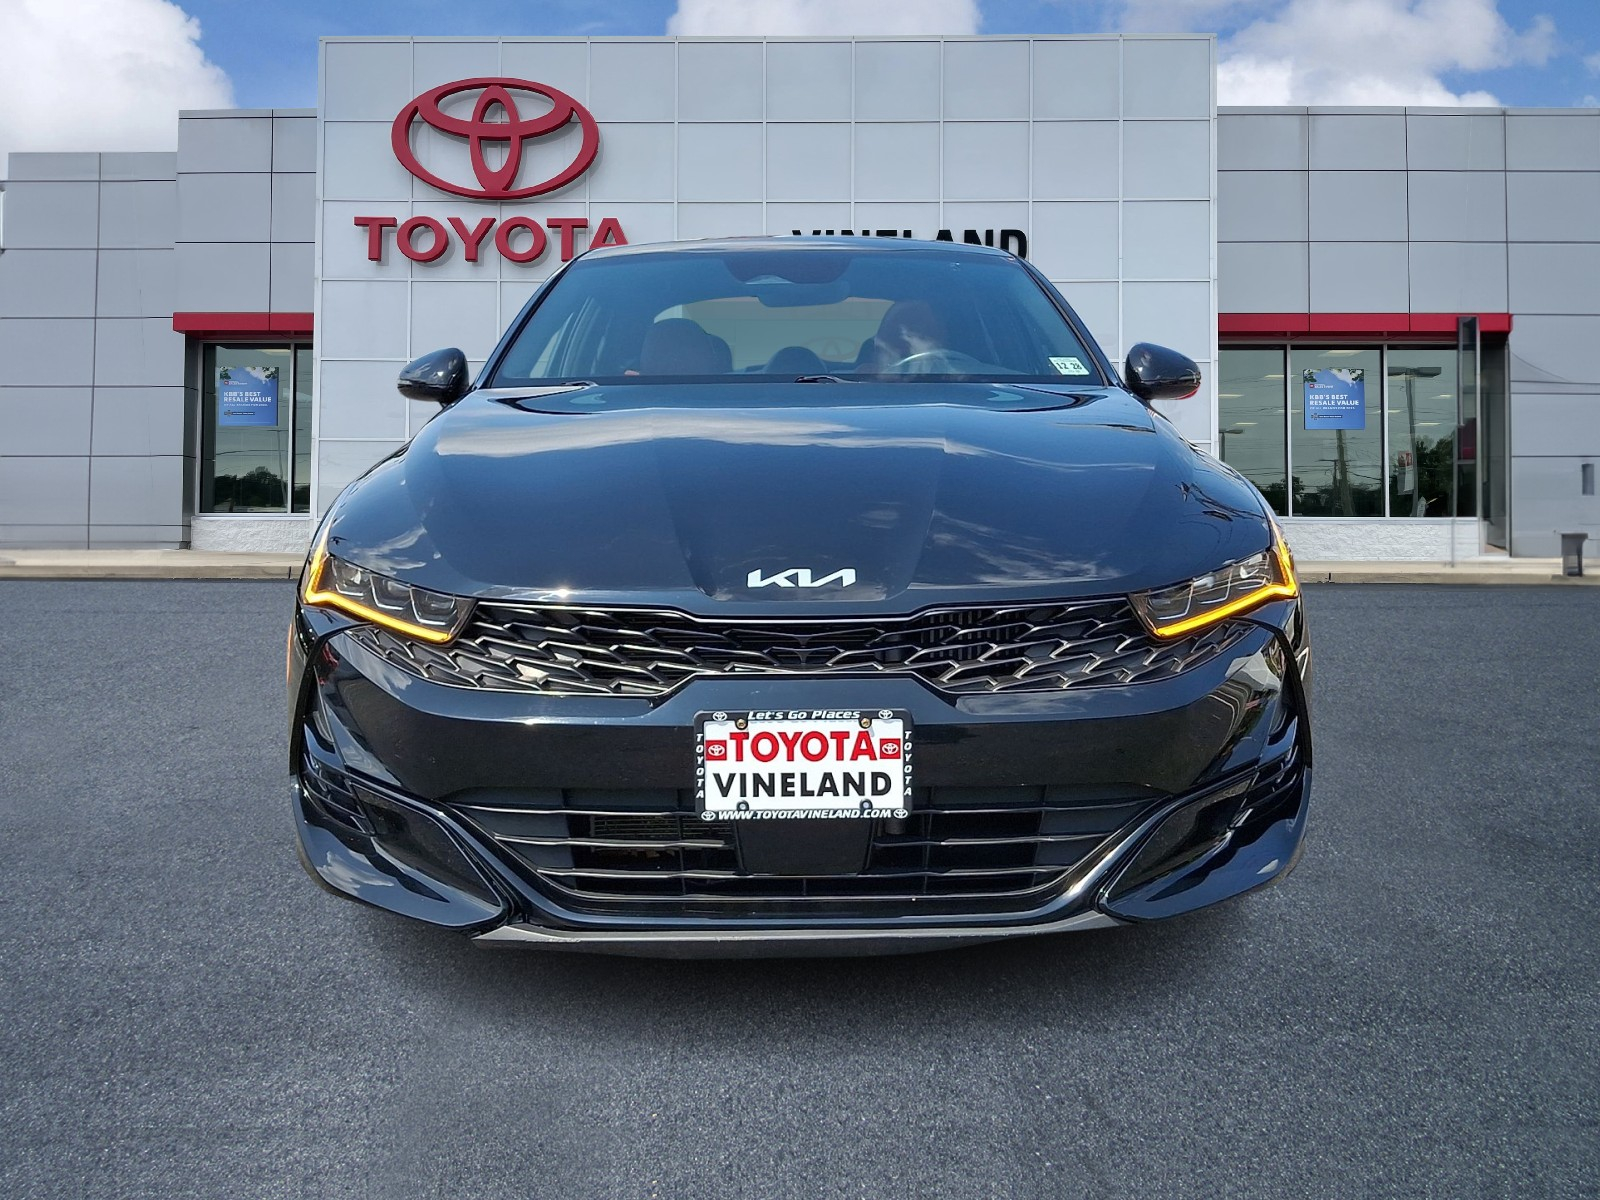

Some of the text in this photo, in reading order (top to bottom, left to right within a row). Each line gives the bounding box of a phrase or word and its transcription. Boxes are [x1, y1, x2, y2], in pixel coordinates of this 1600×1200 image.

[354, 216, 629, 263] TOYOTA
[1056, 362, 1069, 370] 12
[747, 710, 861, 720] Let's Go Places
[729, 731, 878, 763] TOYOTA
[696, 733, 705, 799] TOYOTA
[903, 731, 913, 796] TOYOTA
[713, 771, 892, 798] VINELAND
[718, 808, 892, 820] WWW.TOYOTAVINELAND.COM
